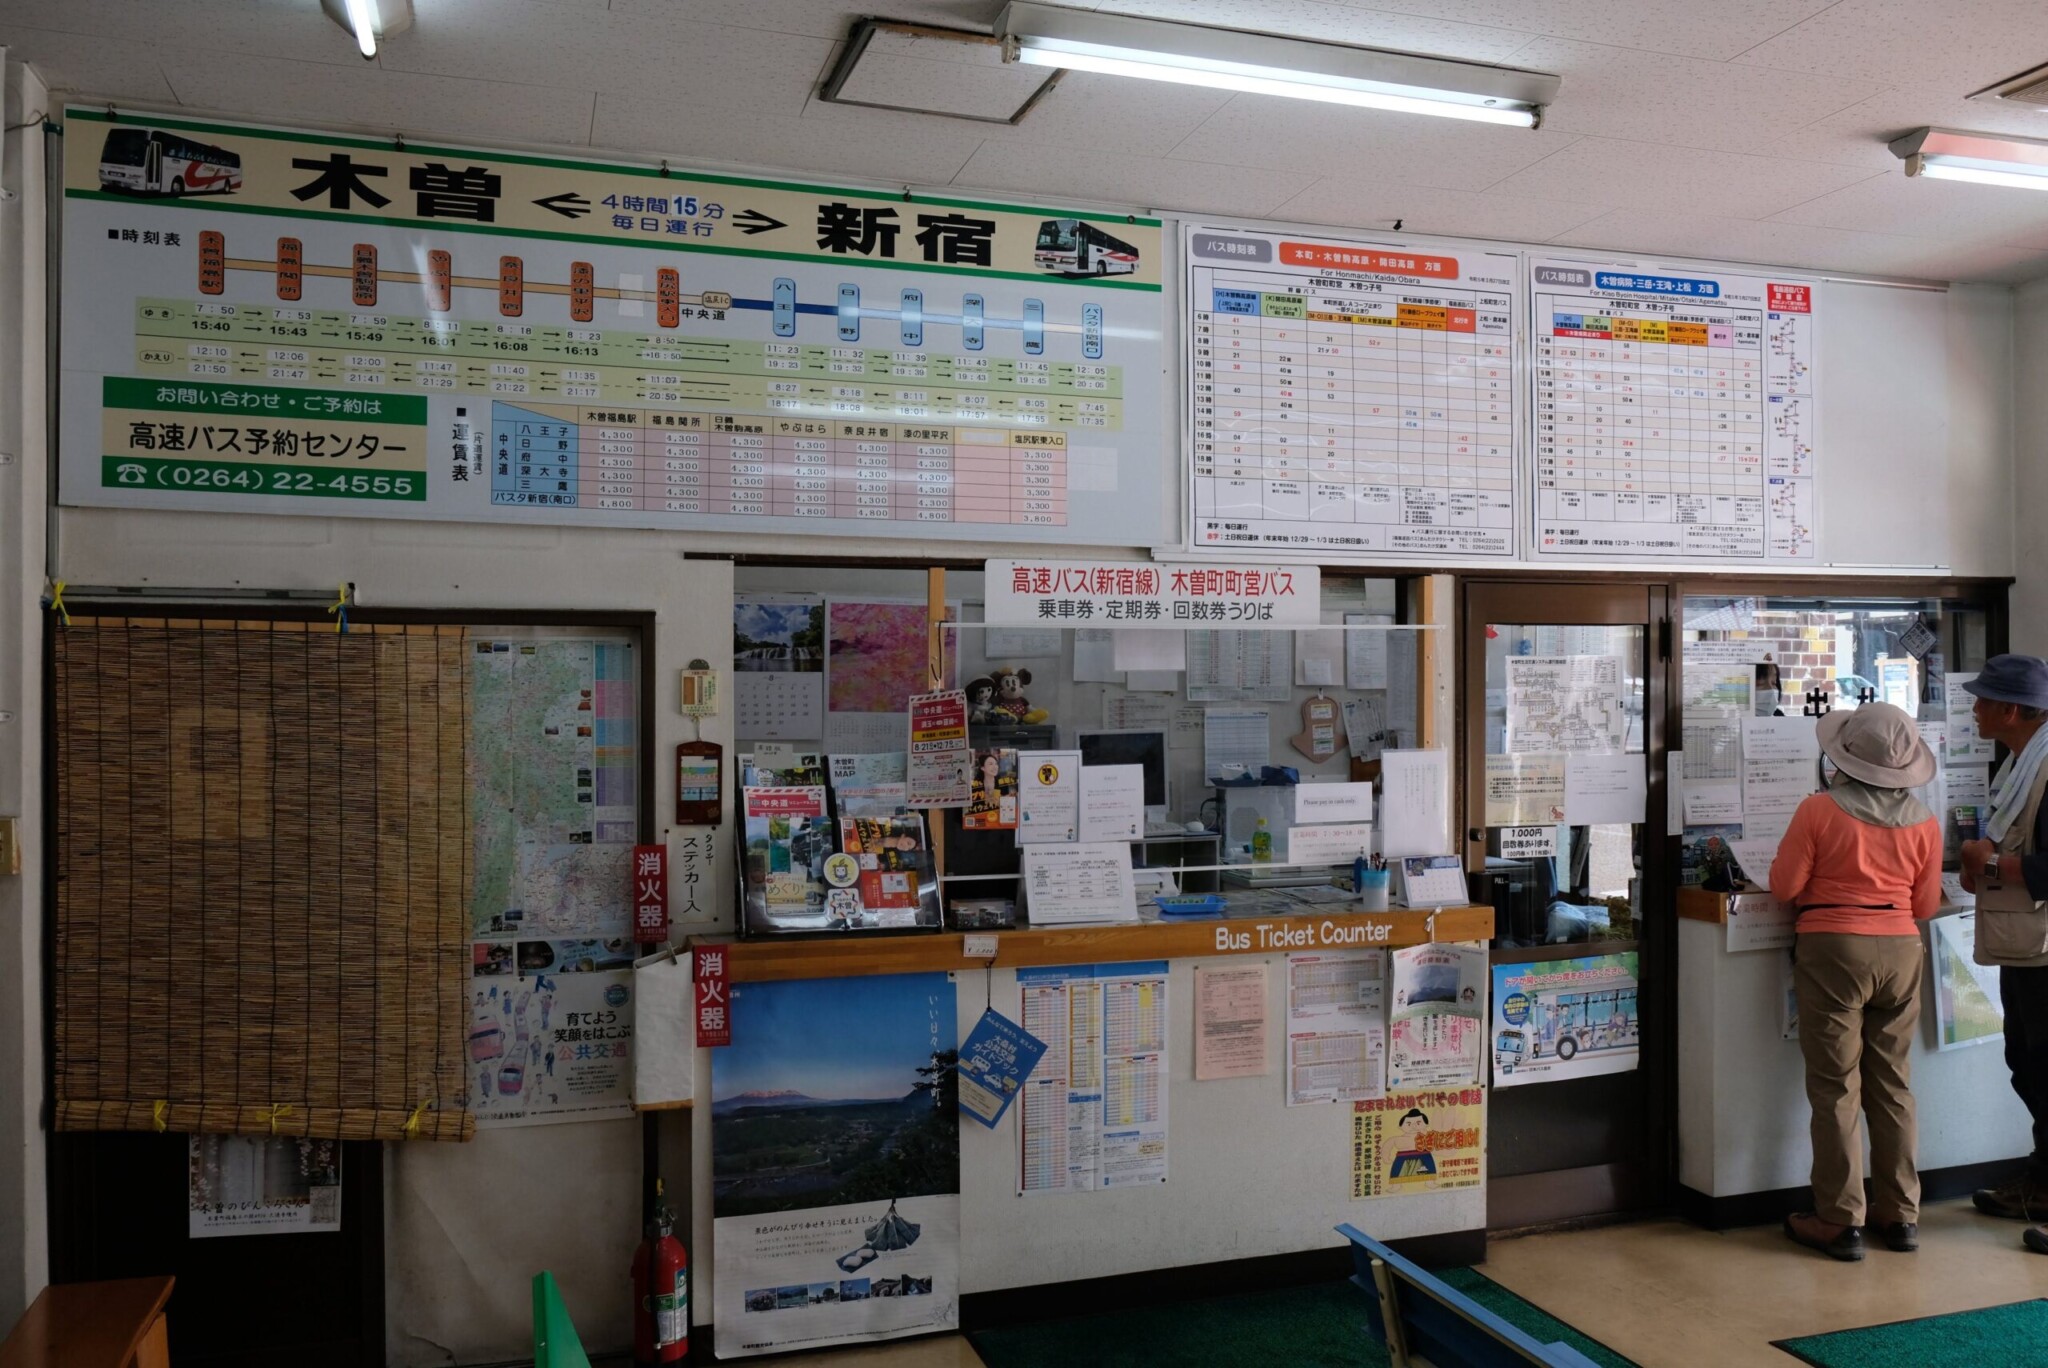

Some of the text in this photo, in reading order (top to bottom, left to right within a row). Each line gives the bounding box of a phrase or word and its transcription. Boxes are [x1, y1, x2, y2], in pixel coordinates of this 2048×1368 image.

[290, 153, 502, 224] 木曽
[601, 193, 725, 219] 4時間15分
[612, 215, 714, 237] 毎日運行
[816, 202, 996, 267] 新宿
[1207, 241, 1257, 256] バス時刻表
[202, 236, 221, 288] 木曽福島駅
[1320, 269, 1333, 277] For
[1425, 261, 1442, 272] 方面
[1541, 270, 1585, 284] バス時刻表
[1698, 283, 1715, 294] 方面
[144, 309, 169, 318] ゆき
[682, 308, 726, 321] 中央道
[191, 320, 231, 332] 15:40
[269, 326, 308, 337] 15:43
[345, 331, 383, 342] 15:49
[493, 342, 529, 352] 16:08
[564, 347, 599, 357] 16:13
[143, 347, 596, 380] かえり 12:10 12:06 12:00 11:47 11:40 11:35
[194, 364, 596, 397] 21:50 21:47 21:41 21:29 21:22 21:17
[156, 386, 382, 416] お問い合わせ・ご予約は
[521, 425, 568, 436] 八王子
[587, 412, 701, 427] 木曽福島駅 福島関所
[128, 421, 407, 457] 高速バス予約センター
[521, 439, 568, 451] 日野
[780, 422, 826, 434] やぶはら
[844, 426, 889, 437] 奈良井宿
[903, 428, 949, 440] 漆の里平沢
[1014, 435, 1064, 446] 塩尻駅東入口
[452, 423, 468, 482] 運賃表
[498, 433, 509, 476] 中央道
[521, 452, 568, 464] 府中
[521, 466, 568, 478] 深大寺
[521, 480, 568, 492] 三鷹
[1012, 567, 1295, 597] 高速バス(新宿線) 木曽町町営バス
[1038, 599, 1273, 621] 乗車券・定期券・回数券うりば
[761, 799, 789, 808] 中央道
[682, 836, 701, 913] ステッカー入
[638, 852, 664, 927] 消火器
[836, 902, 852, 910] 木曽
[1215, 921, 1393, 950] Bus Ticket Counter
[699, 953, 725, 1030] 消火器
[566, 1011, 617, 1026] 育てよう
[554, 1025, 631, 1043] 笑顔をはこぶ
[559, 1042, 627, 1061] 公共交通
[972, 1042, 1019, 1075] ガイドブック
